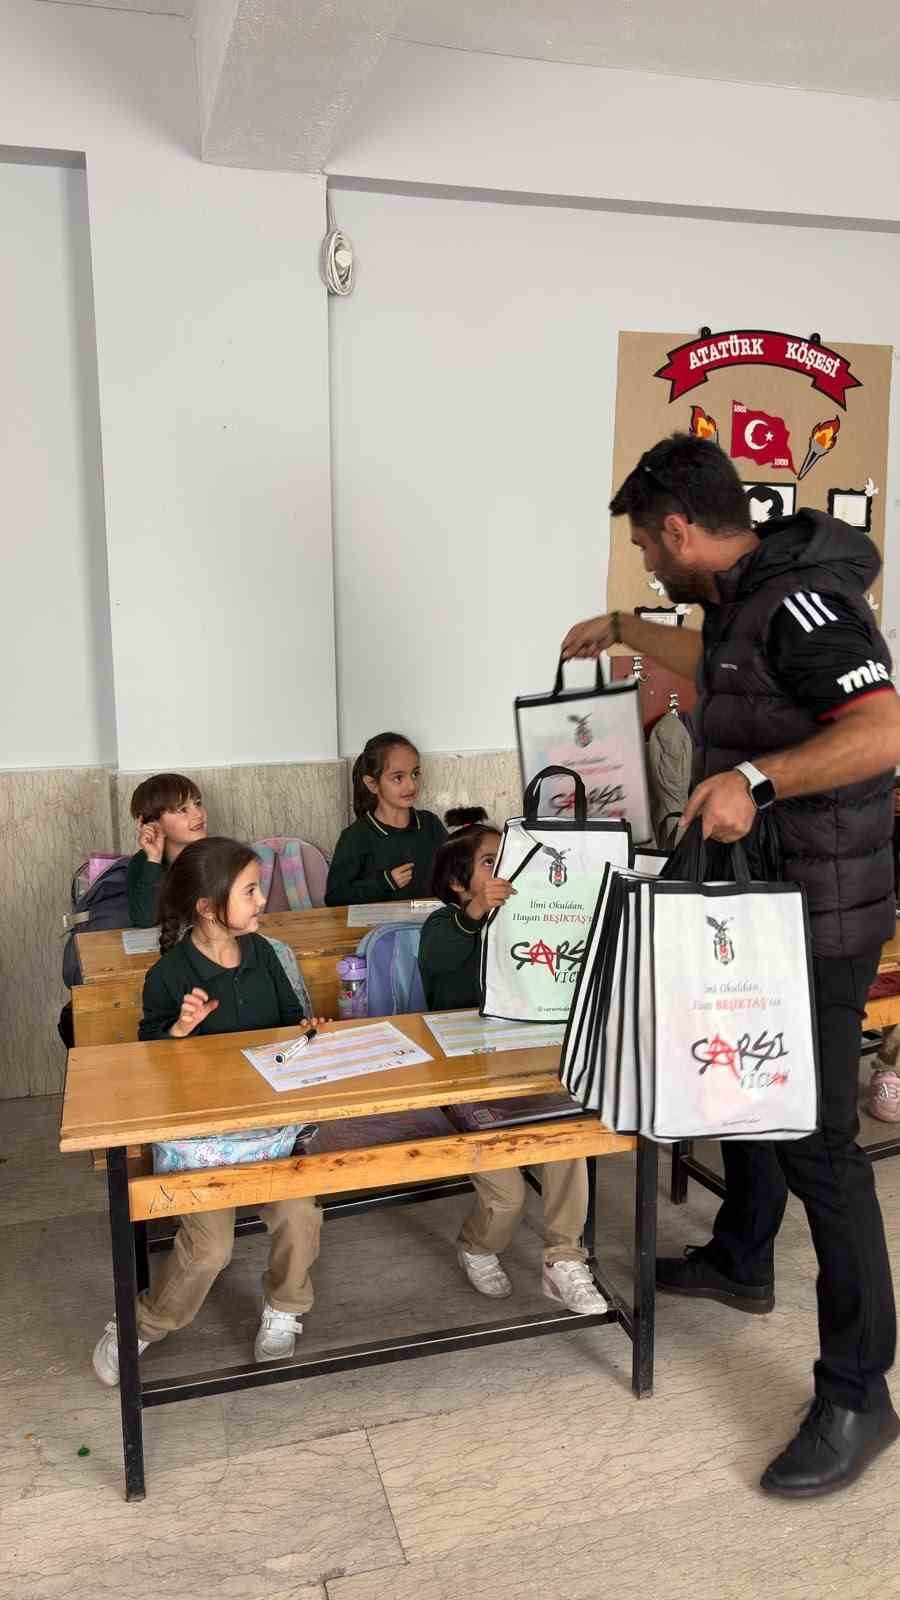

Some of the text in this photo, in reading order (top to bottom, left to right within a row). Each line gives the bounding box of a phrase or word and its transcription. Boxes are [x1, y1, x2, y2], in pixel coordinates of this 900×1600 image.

[689, 335, 841, 378] ATATÜRK KÖŞESİ
[549, 899, 585, 910] Okuldan,
[510, 938, 586, 976] ÇARŞ
[554, 969, 577, 984] VİC
